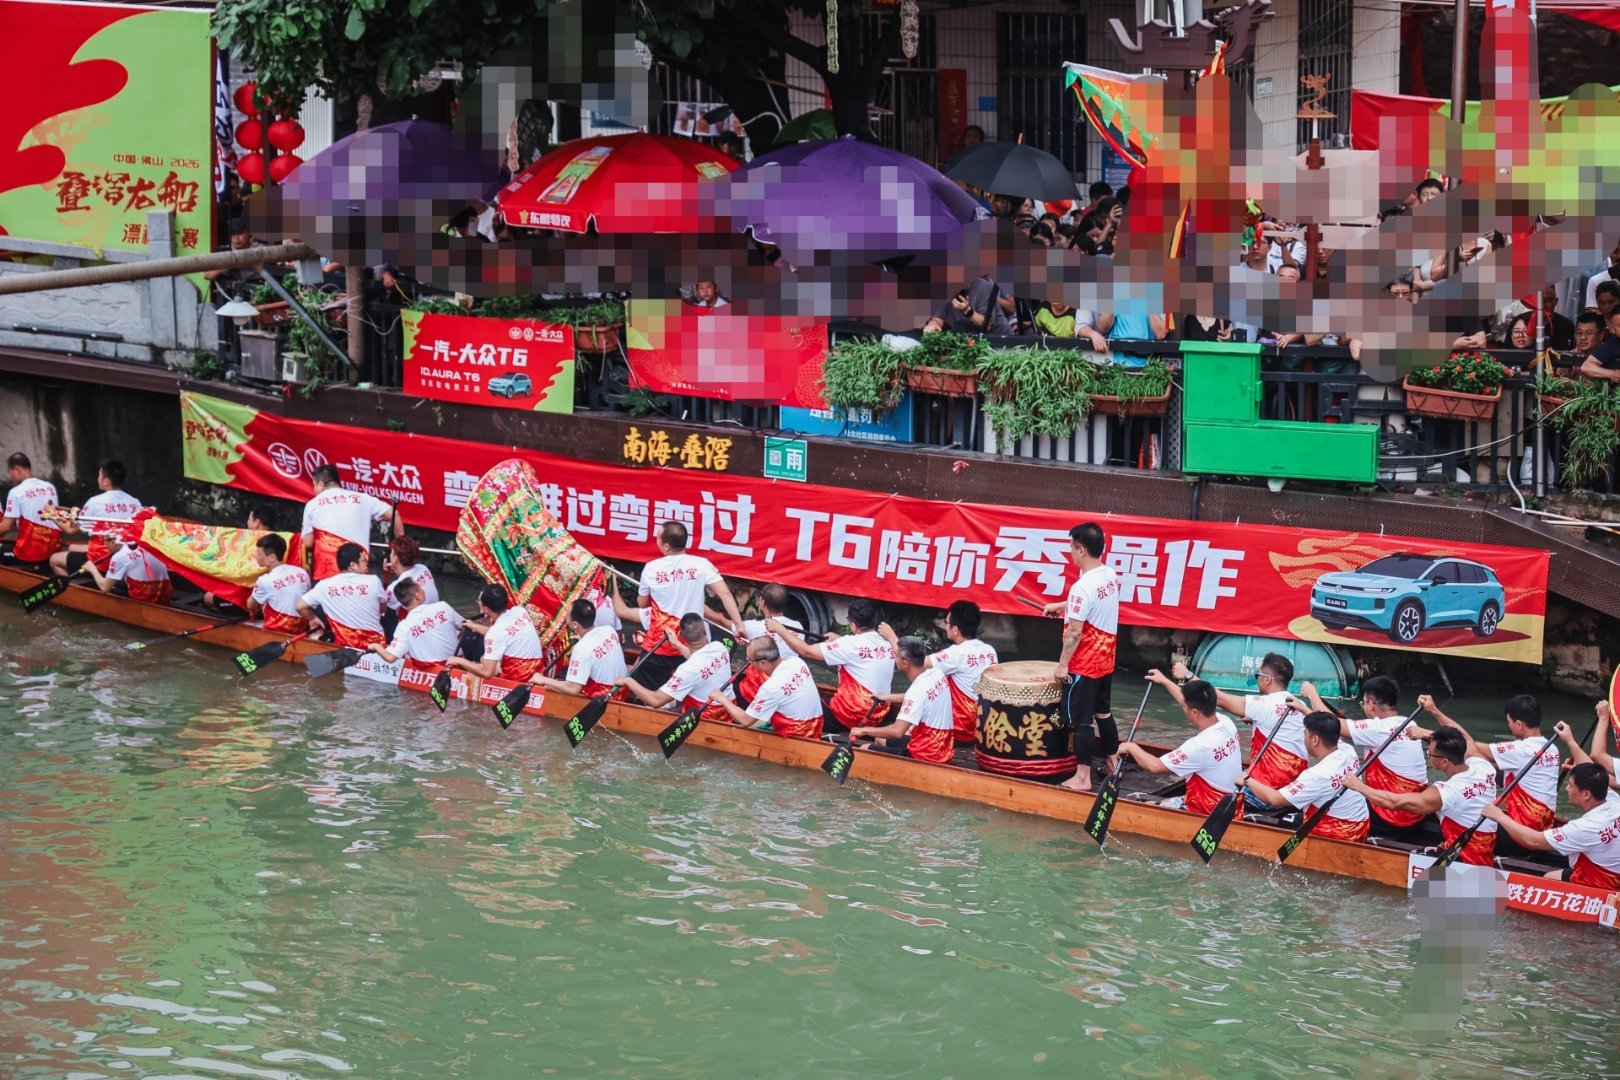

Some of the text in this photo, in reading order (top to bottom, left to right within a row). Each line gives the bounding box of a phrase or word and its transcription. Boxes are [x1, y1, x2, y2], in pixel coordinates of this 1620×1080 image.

[170, 157, 200, 169] 2026
[420, 340, 528, 367] 一汽-大众T6
[420, 366, 481, 382] ID.AURA T6
[786, 447, 804, 472] 雨
[336, 456, 422, 491] 一汽-大众
[656, 568, 698, 584] 敬修堂
[327, 584, 369, 598] 敬修堂
[410, 611, 448, 639] 敬修堂
[700, 652, 730, 681] 敬修堂
[967, 653, 999, 668] 敬修堂
[782, 665, 811, 697] 敬修堂
[1507, 883, 1602, 916] 跌打万花油
